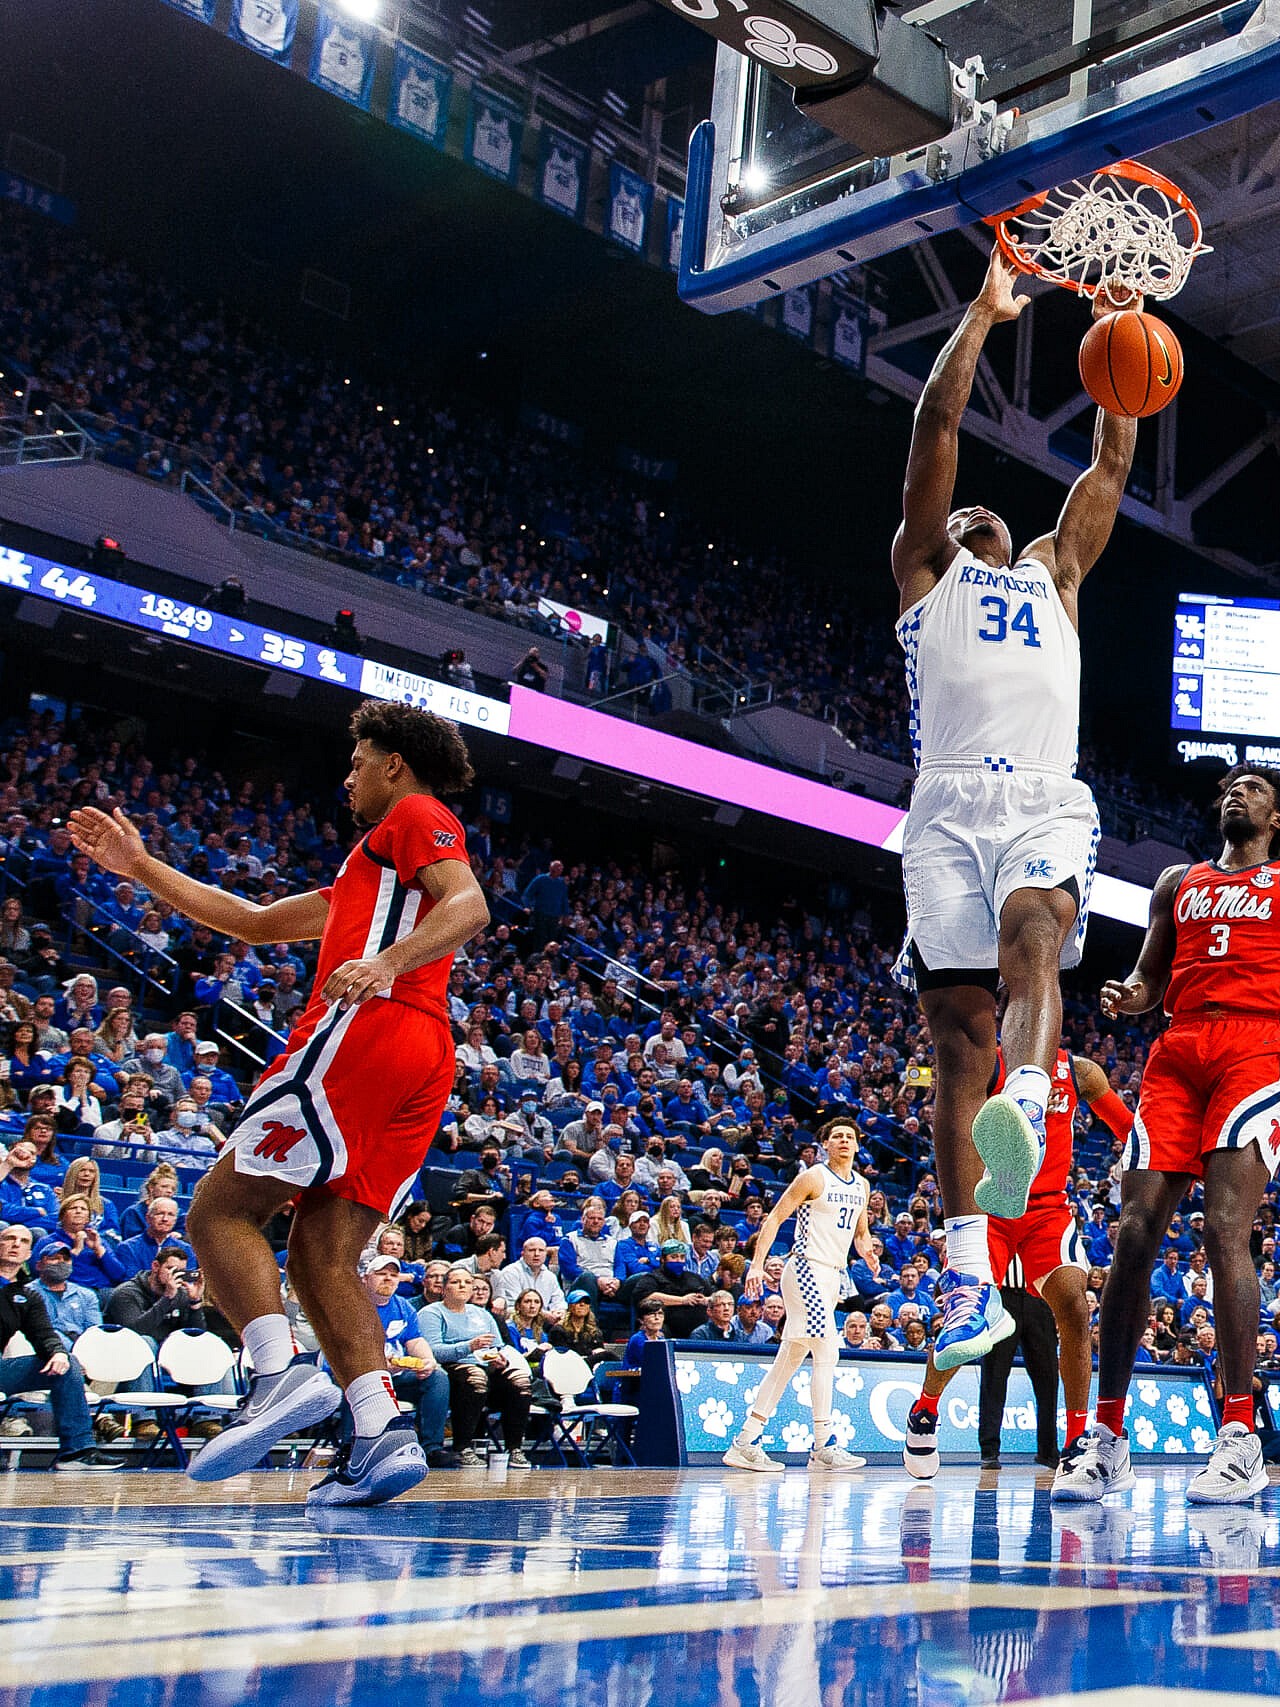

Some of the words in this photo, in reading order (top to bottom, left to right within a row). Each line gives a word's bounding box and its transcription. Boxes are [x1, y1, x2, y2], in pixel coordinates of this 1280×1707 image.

[40, 567, 97, 607] 44
[959, 565, 1048, 599] KENTUCKY
[139, 593, 213, 632] 18:49
[978, 595, 1042, 648] 34
[260, 632, 306, 669] 35
[373, 666, 435, 697] TIMEOUTS
[449, 696, 471, 716] FLS
[1177, 886, 1211, 923] Ole
[1211, 884, 1273, 920] Miss
[1208, 924, 1231, 957] 3
[837, 1207, 855, 1230] 31
